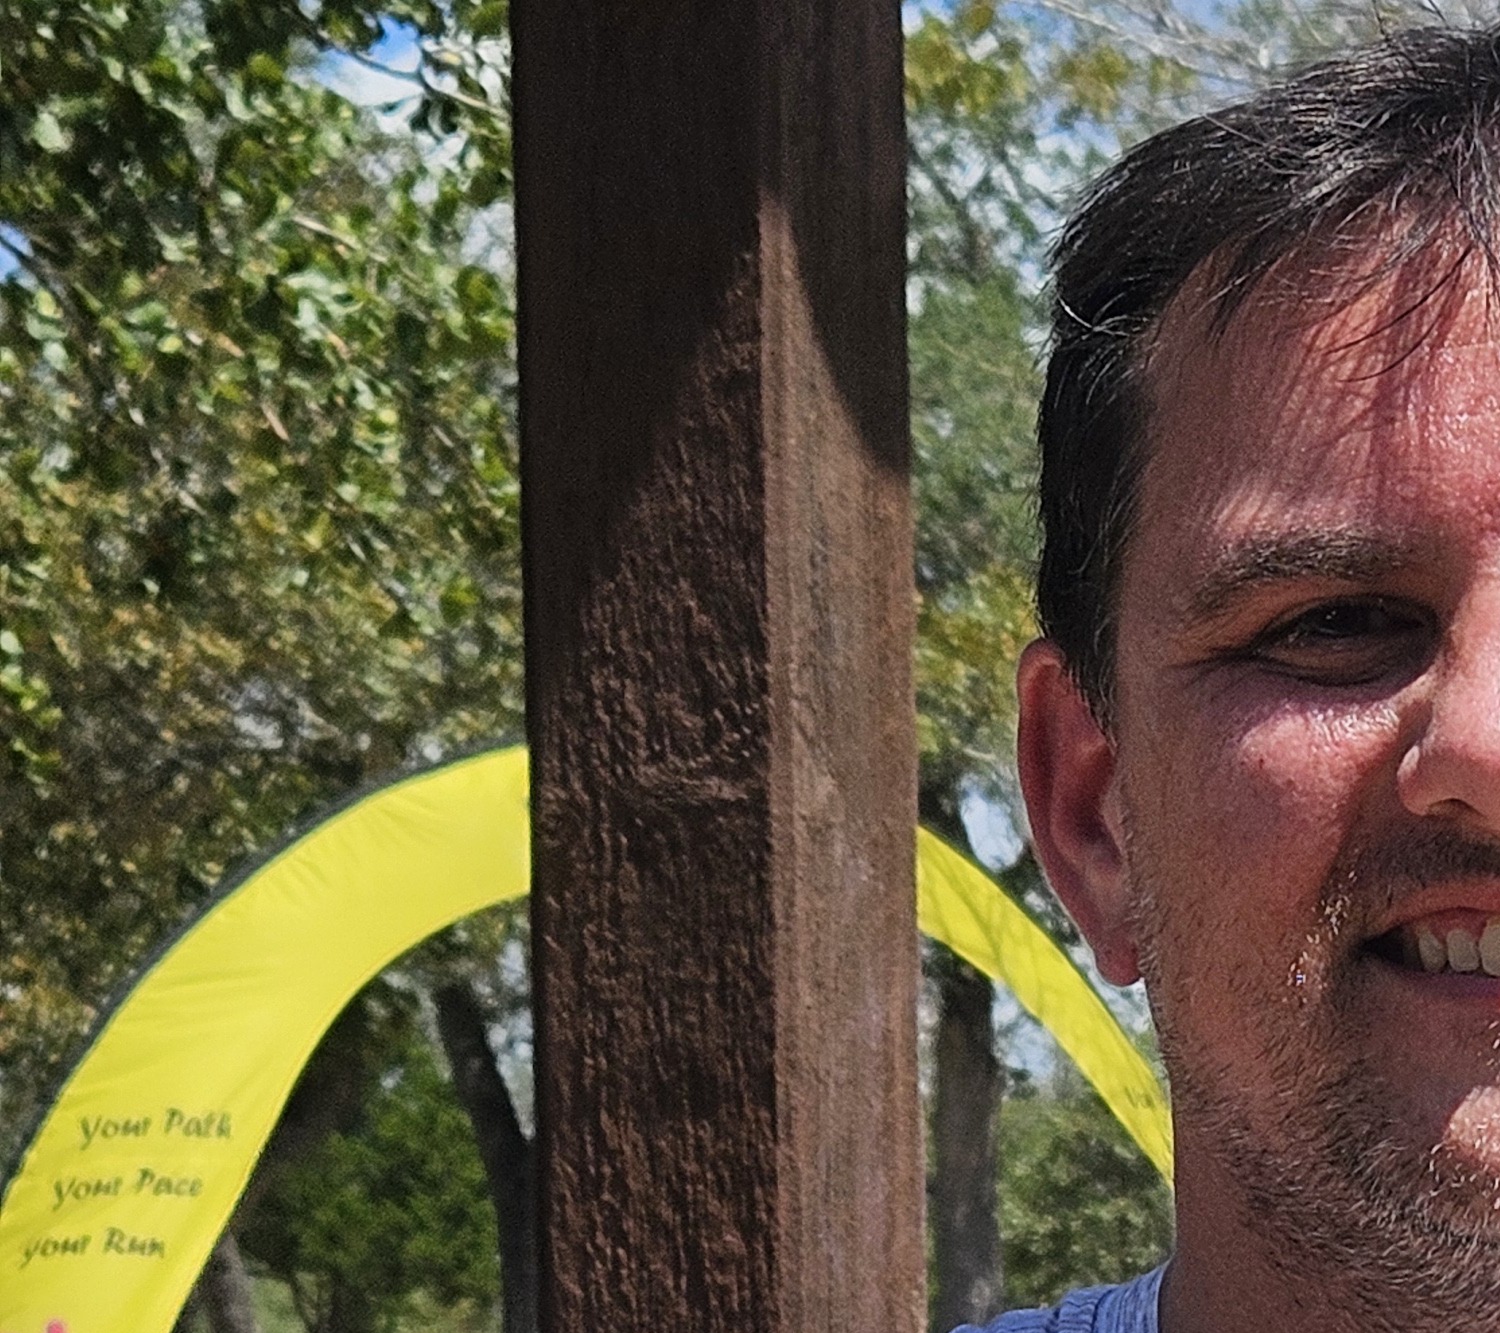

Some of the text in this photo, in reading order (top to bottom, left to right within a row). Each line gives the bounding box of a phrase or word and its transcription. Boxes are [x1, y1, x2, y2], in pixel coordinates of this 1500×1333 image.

[164, 1107, 232, 1139] Path
[135, 1167, 203, 1197] Pace
[103, 1226, 166, 1259] Run
